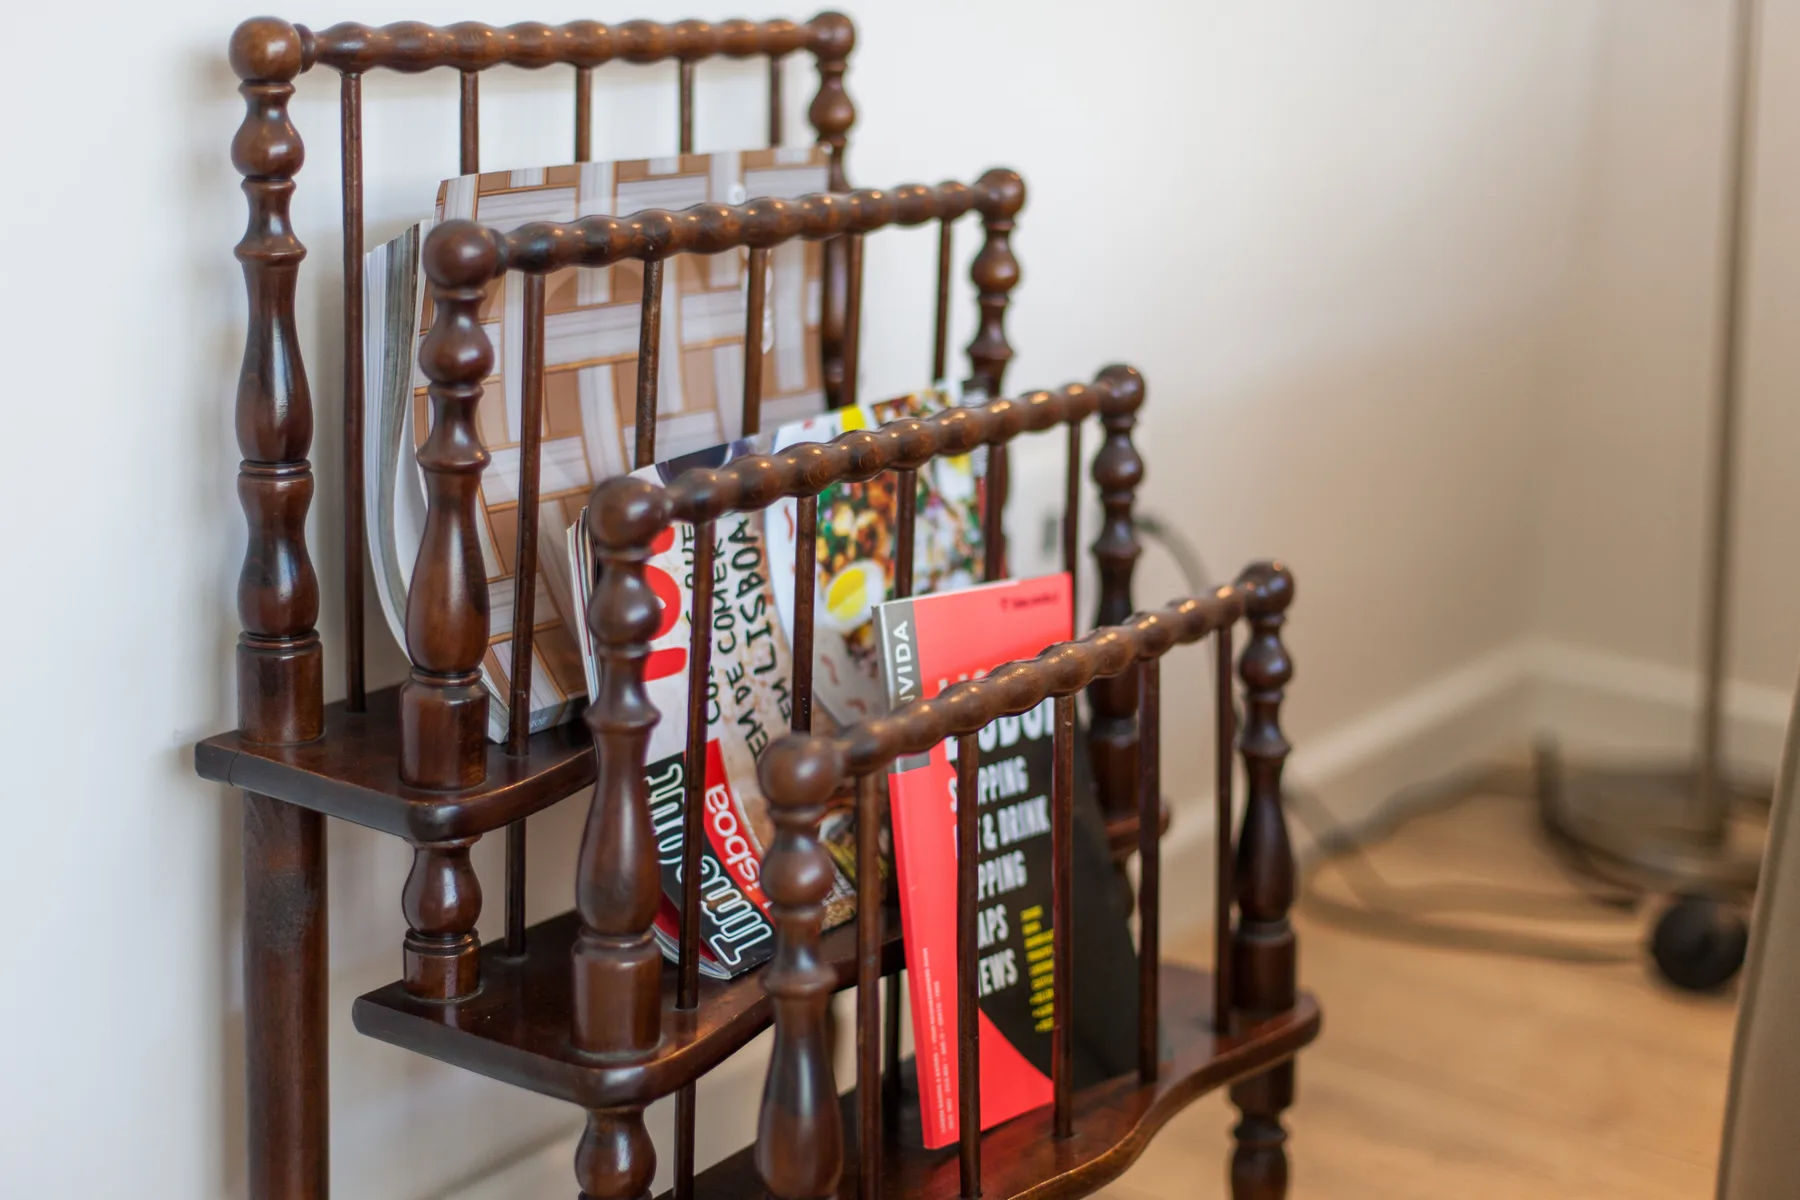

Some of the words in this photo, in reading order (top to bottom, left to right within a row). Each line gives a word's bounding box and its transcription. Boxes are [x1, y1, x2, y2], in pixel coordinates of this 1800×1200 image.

[728, 516, 778, 677] LISBOA
[726, 661, 752, 706] DE
[893, 620, 915, 703] VIDA
[738, 706, 769, 762] EM
[948, 754, 1029, 814] SPPING
[705, 783, 773, 909] isboa
[982, 812, 998, 851] &
[978, 849, 1028, 902] PPING
[977, 903, 1010, 950] APS
[978, 947, 1019, 999] EWS
